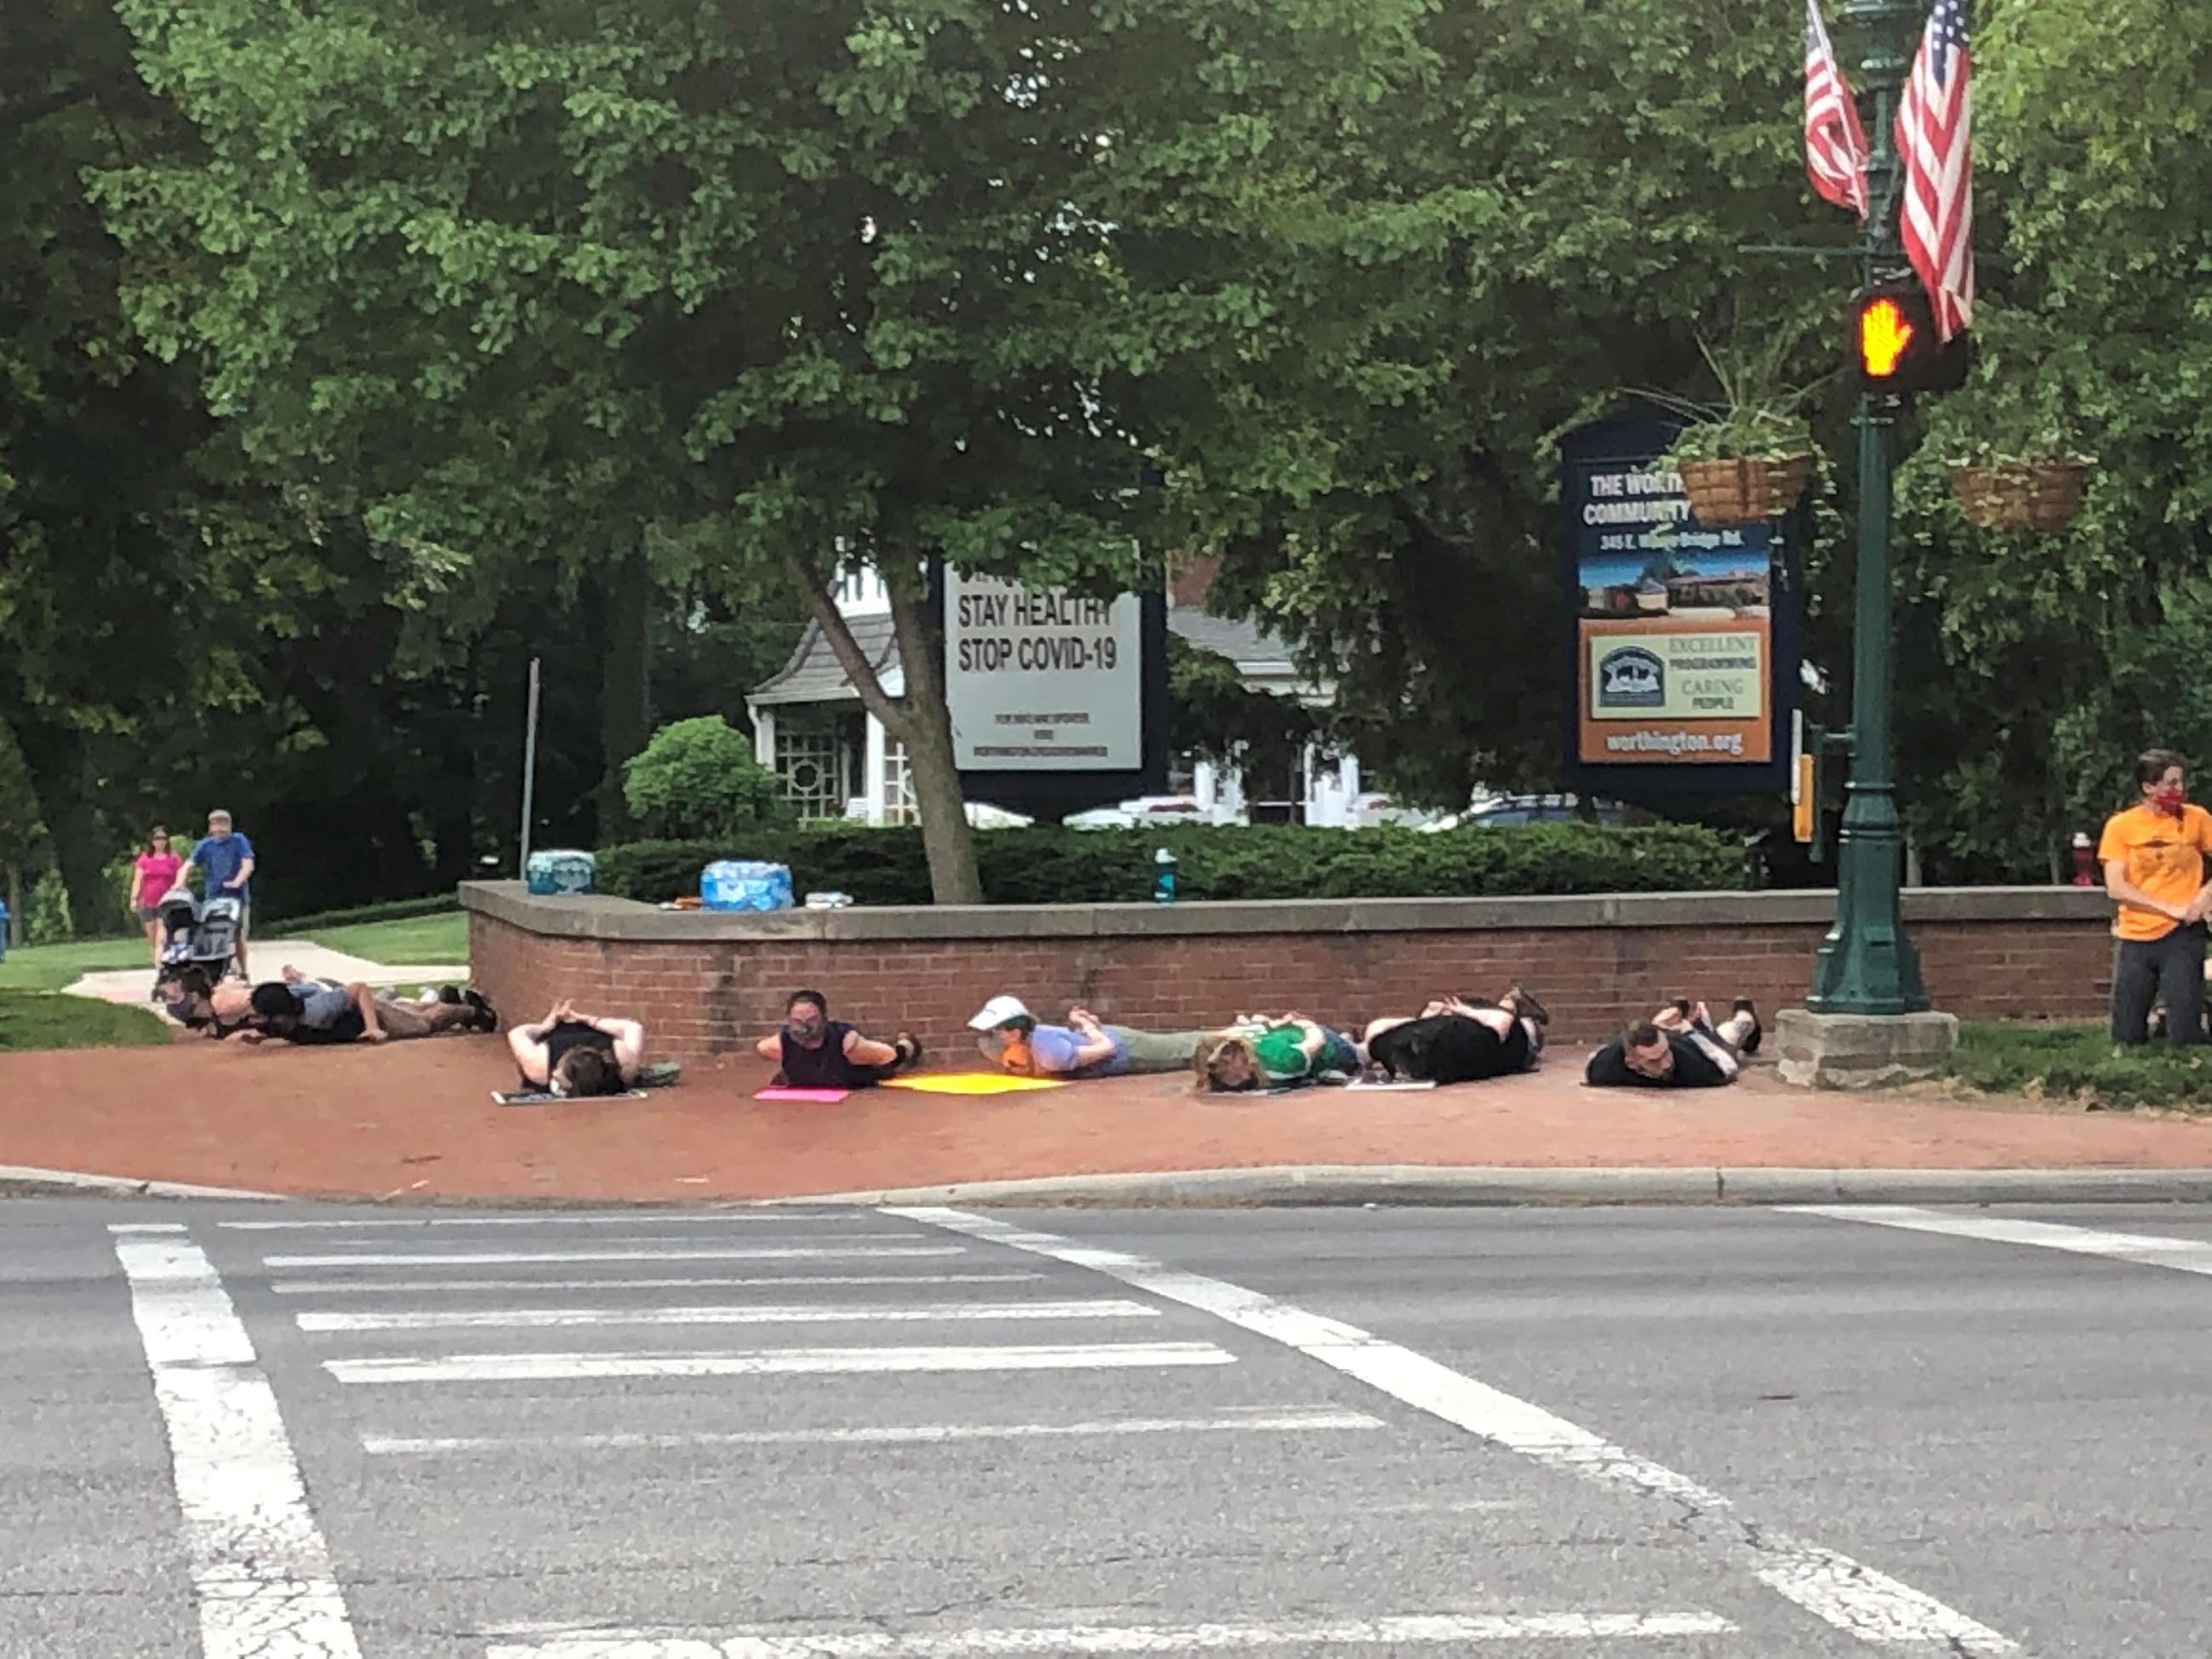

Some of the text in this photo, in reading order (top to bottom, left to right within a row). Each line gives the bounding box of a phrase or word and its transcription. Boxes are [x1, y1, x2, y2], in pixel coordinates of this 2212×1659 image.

[1590, 474, 1624, 497] THE
[959, 594, 1008, 628] STAY
[958, 636, 1118, 671] STOP COVID-19
[1606, 731, 1743, 755] worthington.org
